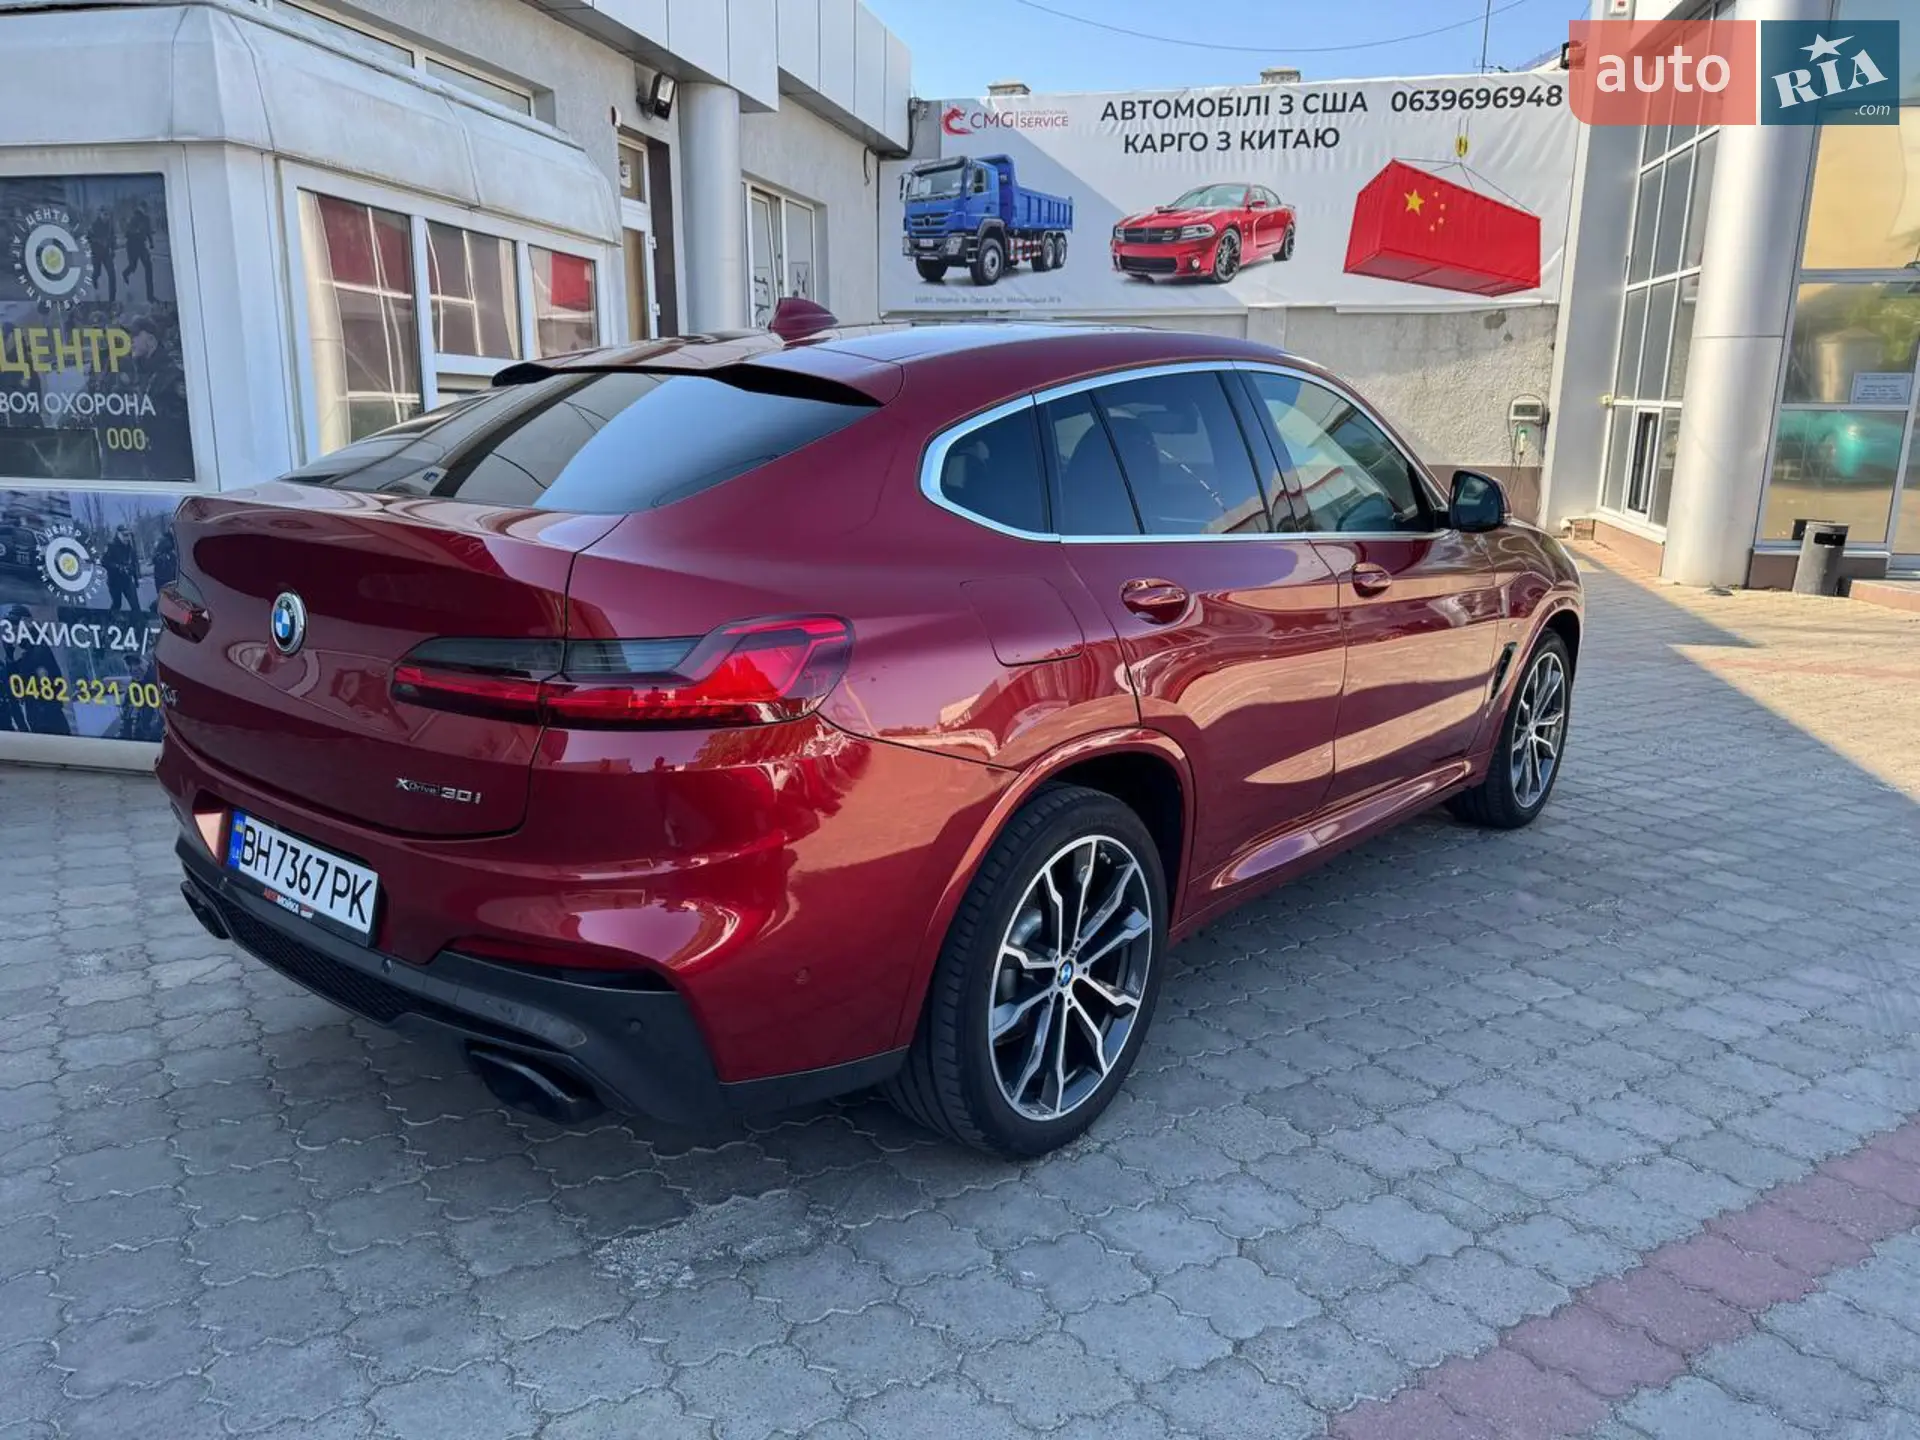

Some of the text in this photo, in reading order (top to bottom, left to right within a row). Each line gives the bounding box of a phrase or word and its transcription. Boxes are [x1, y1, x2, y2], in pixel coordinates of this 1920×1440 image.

[1101, 95, 1270, 121] АВТОМОБІЛІ
[1303, 91, 1368, 115] США
[1391, 84, 1563, 112] 0639696948
[1020, 116, 1069, 128] SERVICE
[1124, 132, 1208, 153] КАРГО
[1240, 127, 1340, 150] КИТАЮ
[25, 208, 70, 225] ЦЕНТР
[0, 328, 132, 379] ЦЕНТР
[44, 392, 156, 417] ОХОРОНА
[0, 619, 101, 649] ЗАХИСТ
[9, 674, 160, 709] 0482 321 00
